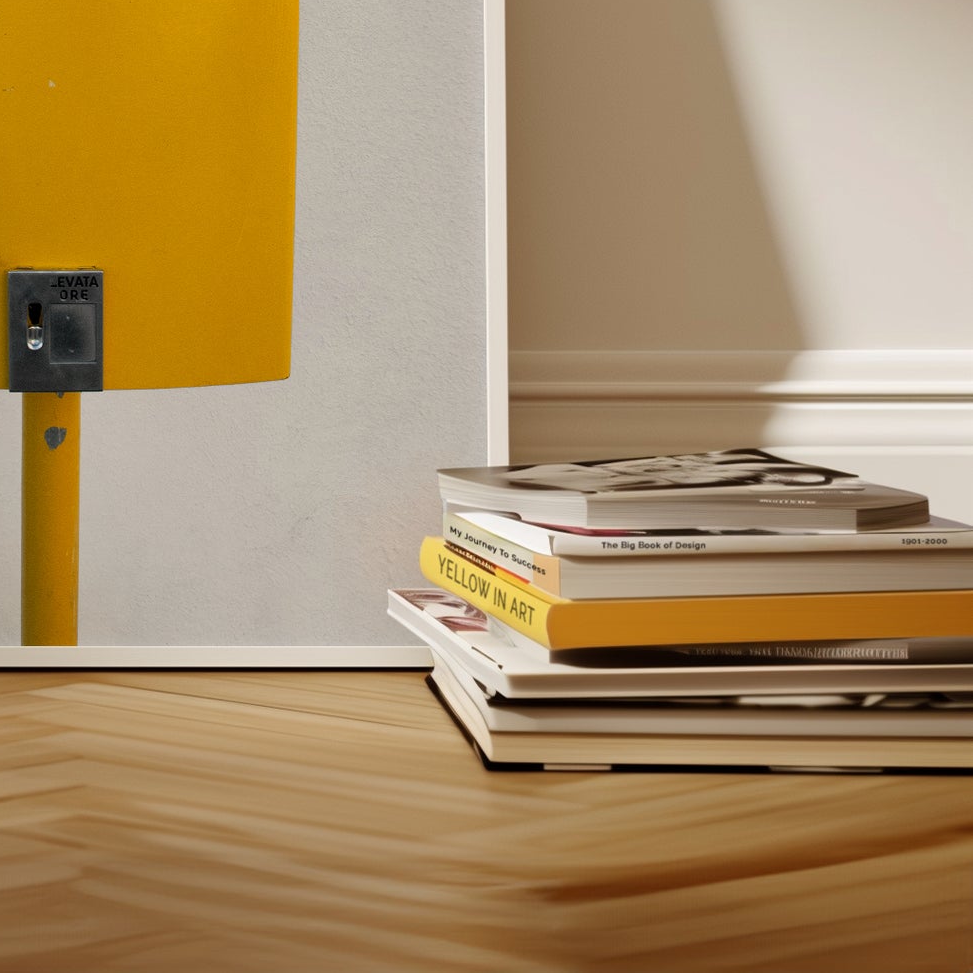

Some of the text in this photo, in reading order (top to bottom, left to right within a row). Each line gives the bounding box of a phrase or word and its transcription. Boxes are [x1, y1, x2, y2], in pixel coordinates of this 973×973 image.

[50, 276, 99, 288] EVATA
[60, 290, 89, 300] ORE
[449, 526, 462, 538] My
[464, 533, 497, 554] Journey
[499, 548, 509, 558] To
[511, 554, 546, 575] Success
[601, 541, 706, 551] The Big Book of Design
[438, 553, 490, 599] YELLOW
[493, 587, 507, 610] IN
[509, 597, 535, 626] ART
